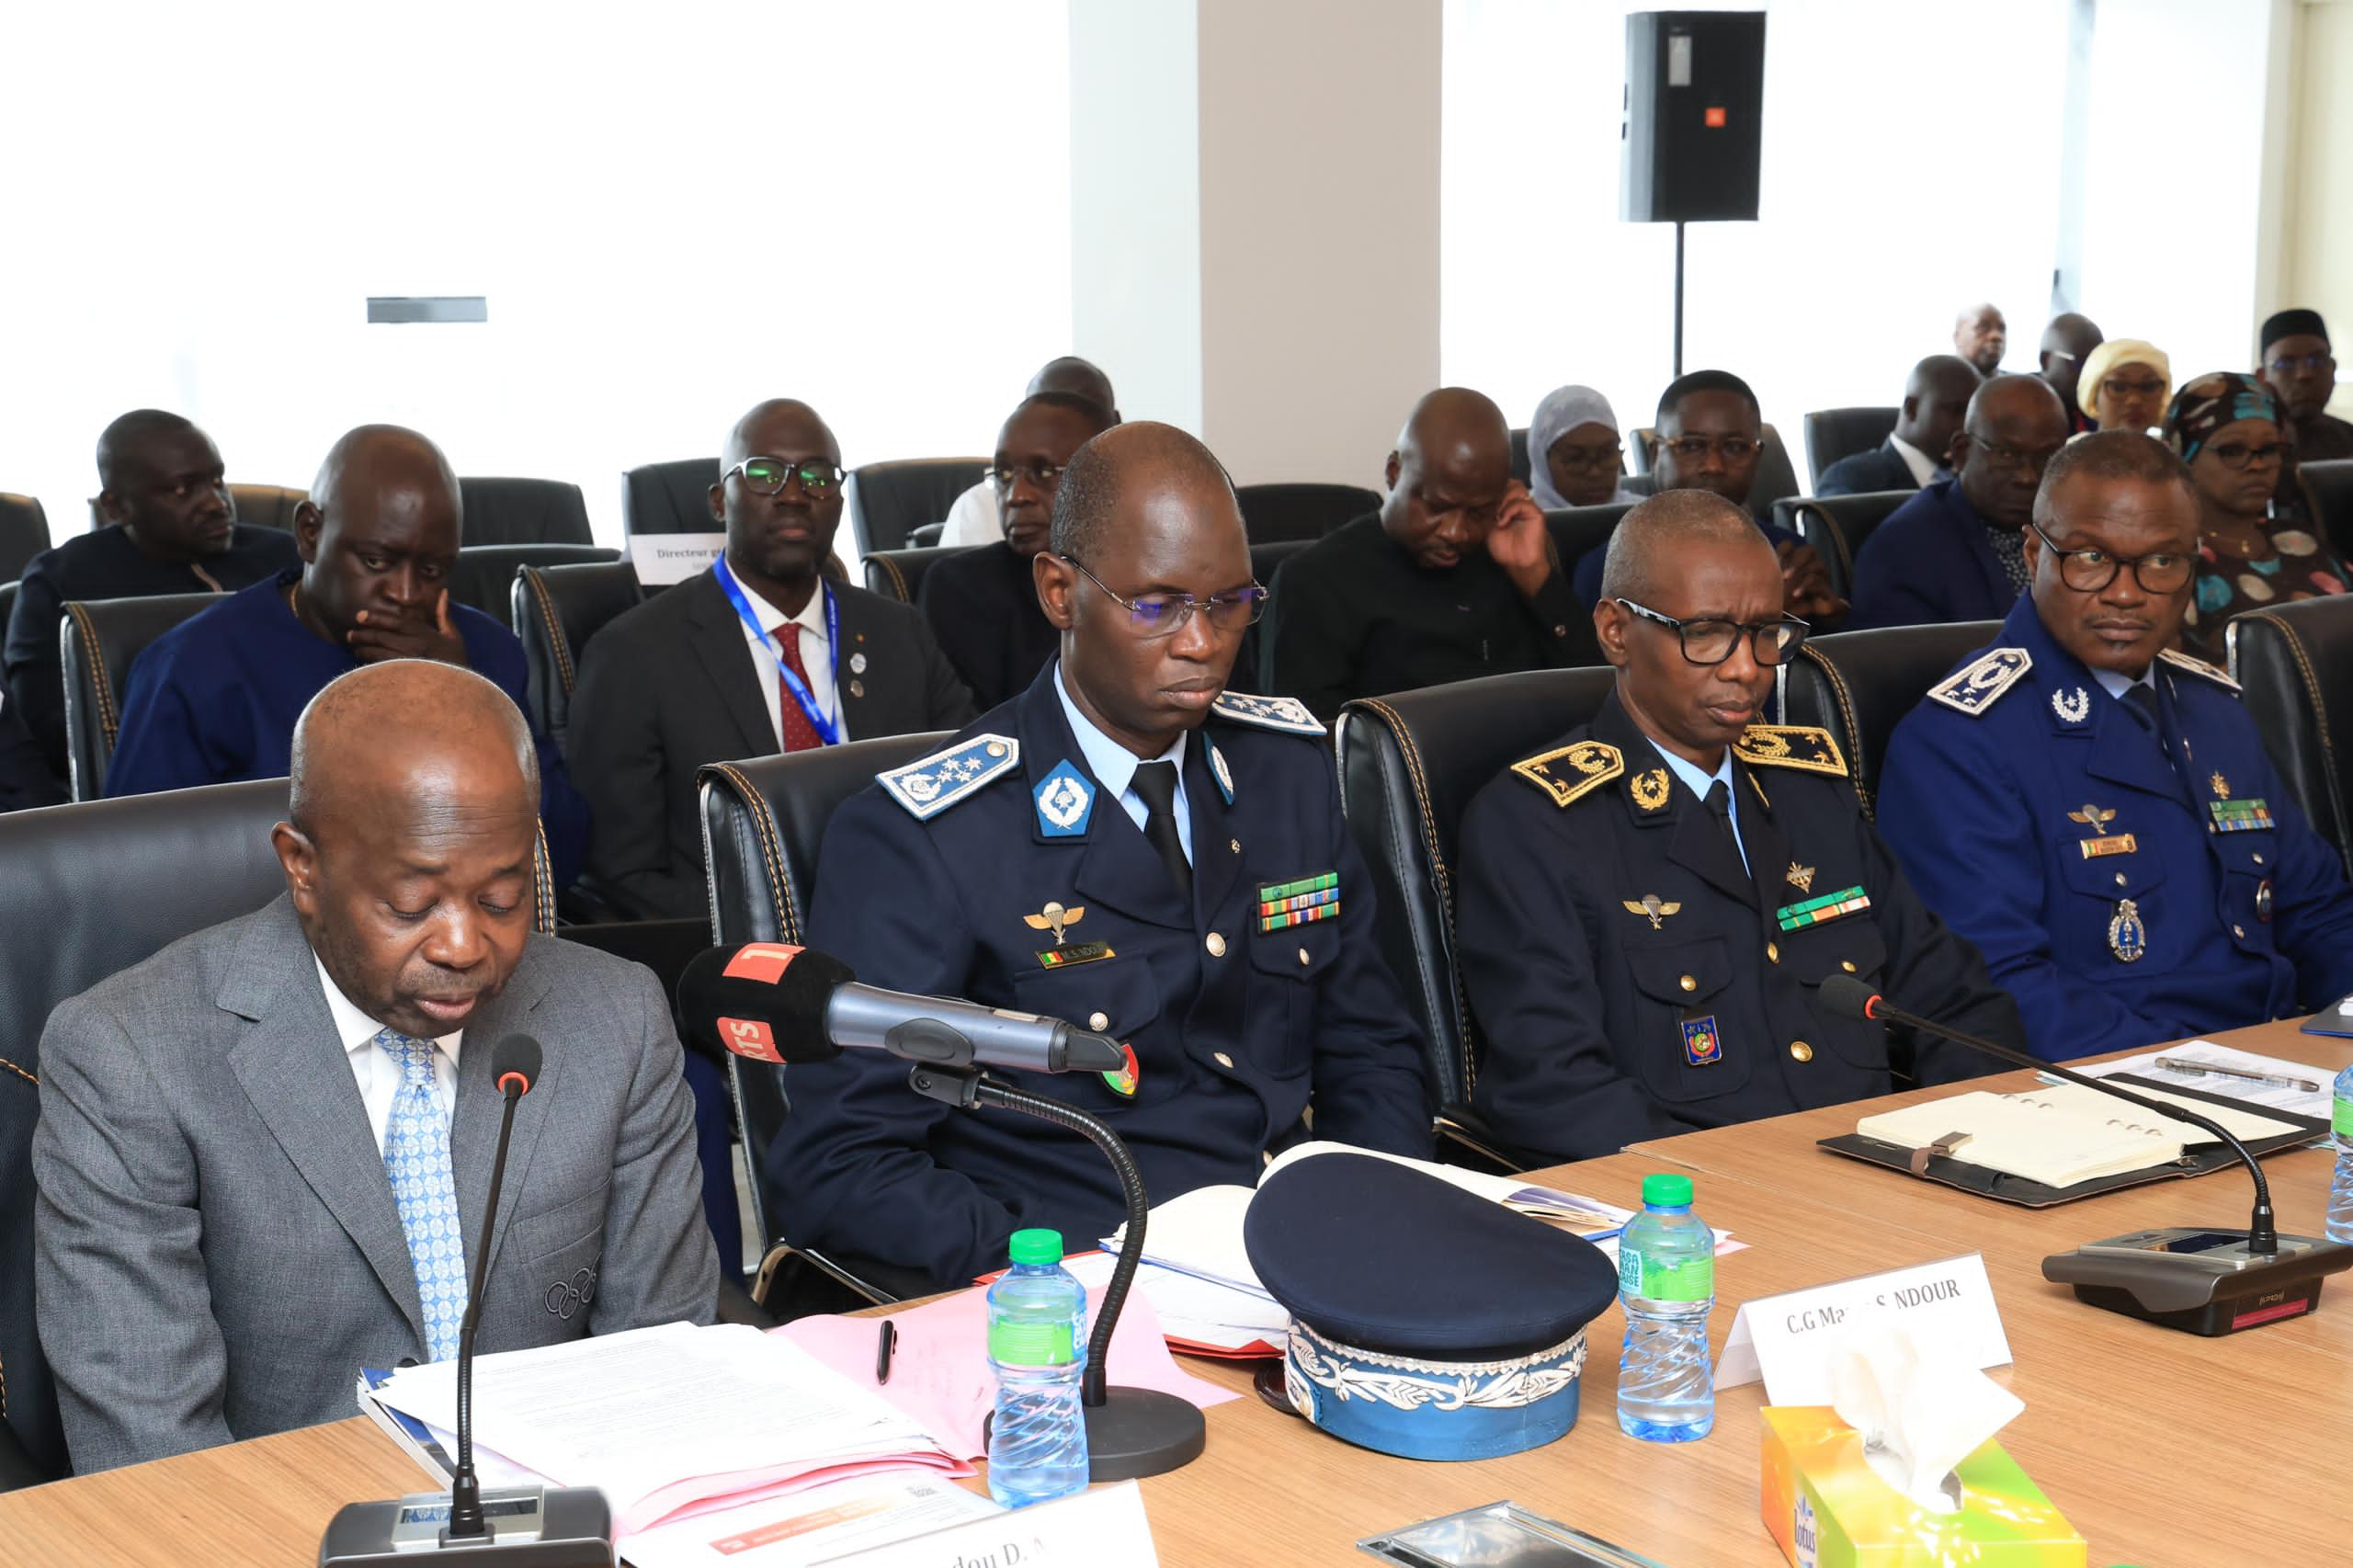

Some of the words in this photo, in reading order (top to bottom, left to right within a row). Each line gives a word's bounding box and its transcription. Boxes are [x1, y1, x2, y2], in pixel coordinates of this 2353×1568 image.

[740, 949, 790, 960] 1
[1893, 1278, 1961, 1310] NDOUR
[1794, 1508, 1815, 1554] lotus
